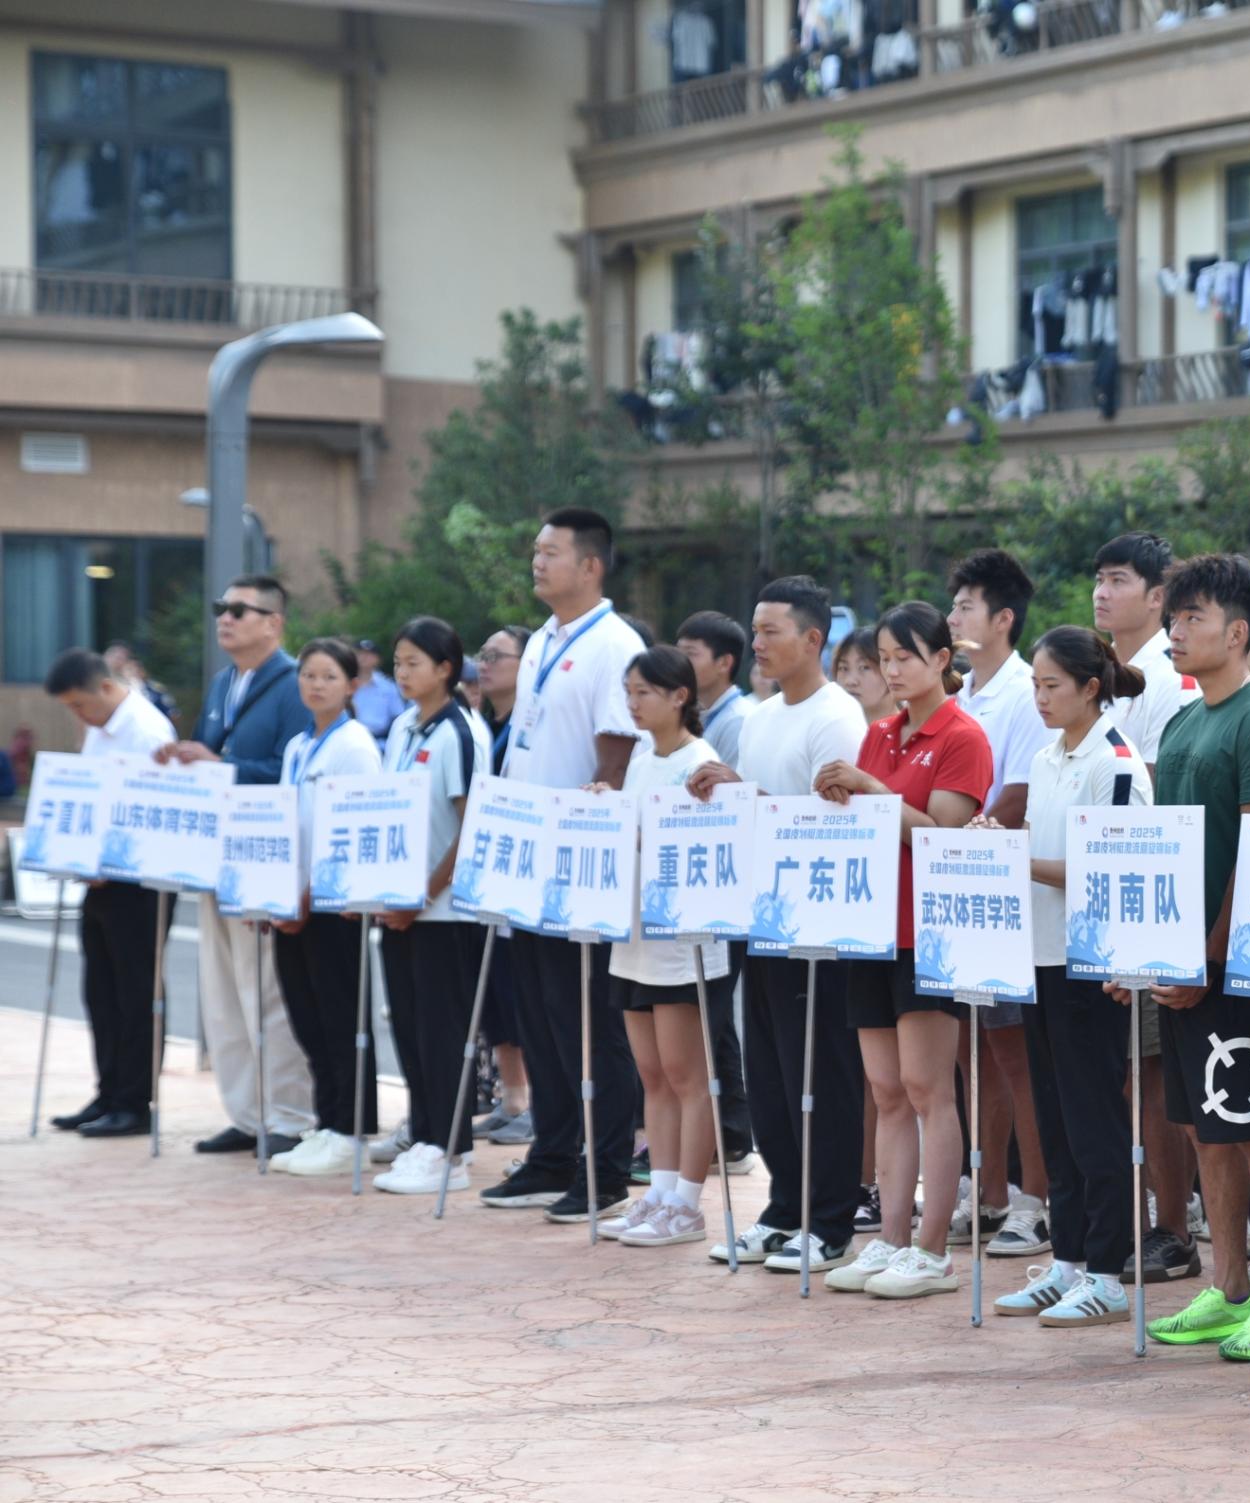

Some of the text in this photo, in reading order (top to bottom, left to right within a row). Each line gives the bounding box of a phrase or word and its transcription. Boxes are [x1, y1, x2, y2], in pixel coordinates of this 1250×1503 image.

[110, 802, 219, 839] 山东体育学院
[822, 814, 858, 826] 2025年
[1130, 826, 1163, 839] 2025年
[329, 824, 409, 866] 云南队
[472, 828, 535, 881] 甘肃队
[657, 842, 738, 889] 重庆队
[555, 845, 618, 890] 四川队
[772, 855, 873, 904] 广东队
[921, 891, 1022, 931] 武汉体育学院
[1084, 872, 1181, 924] 湖南队
